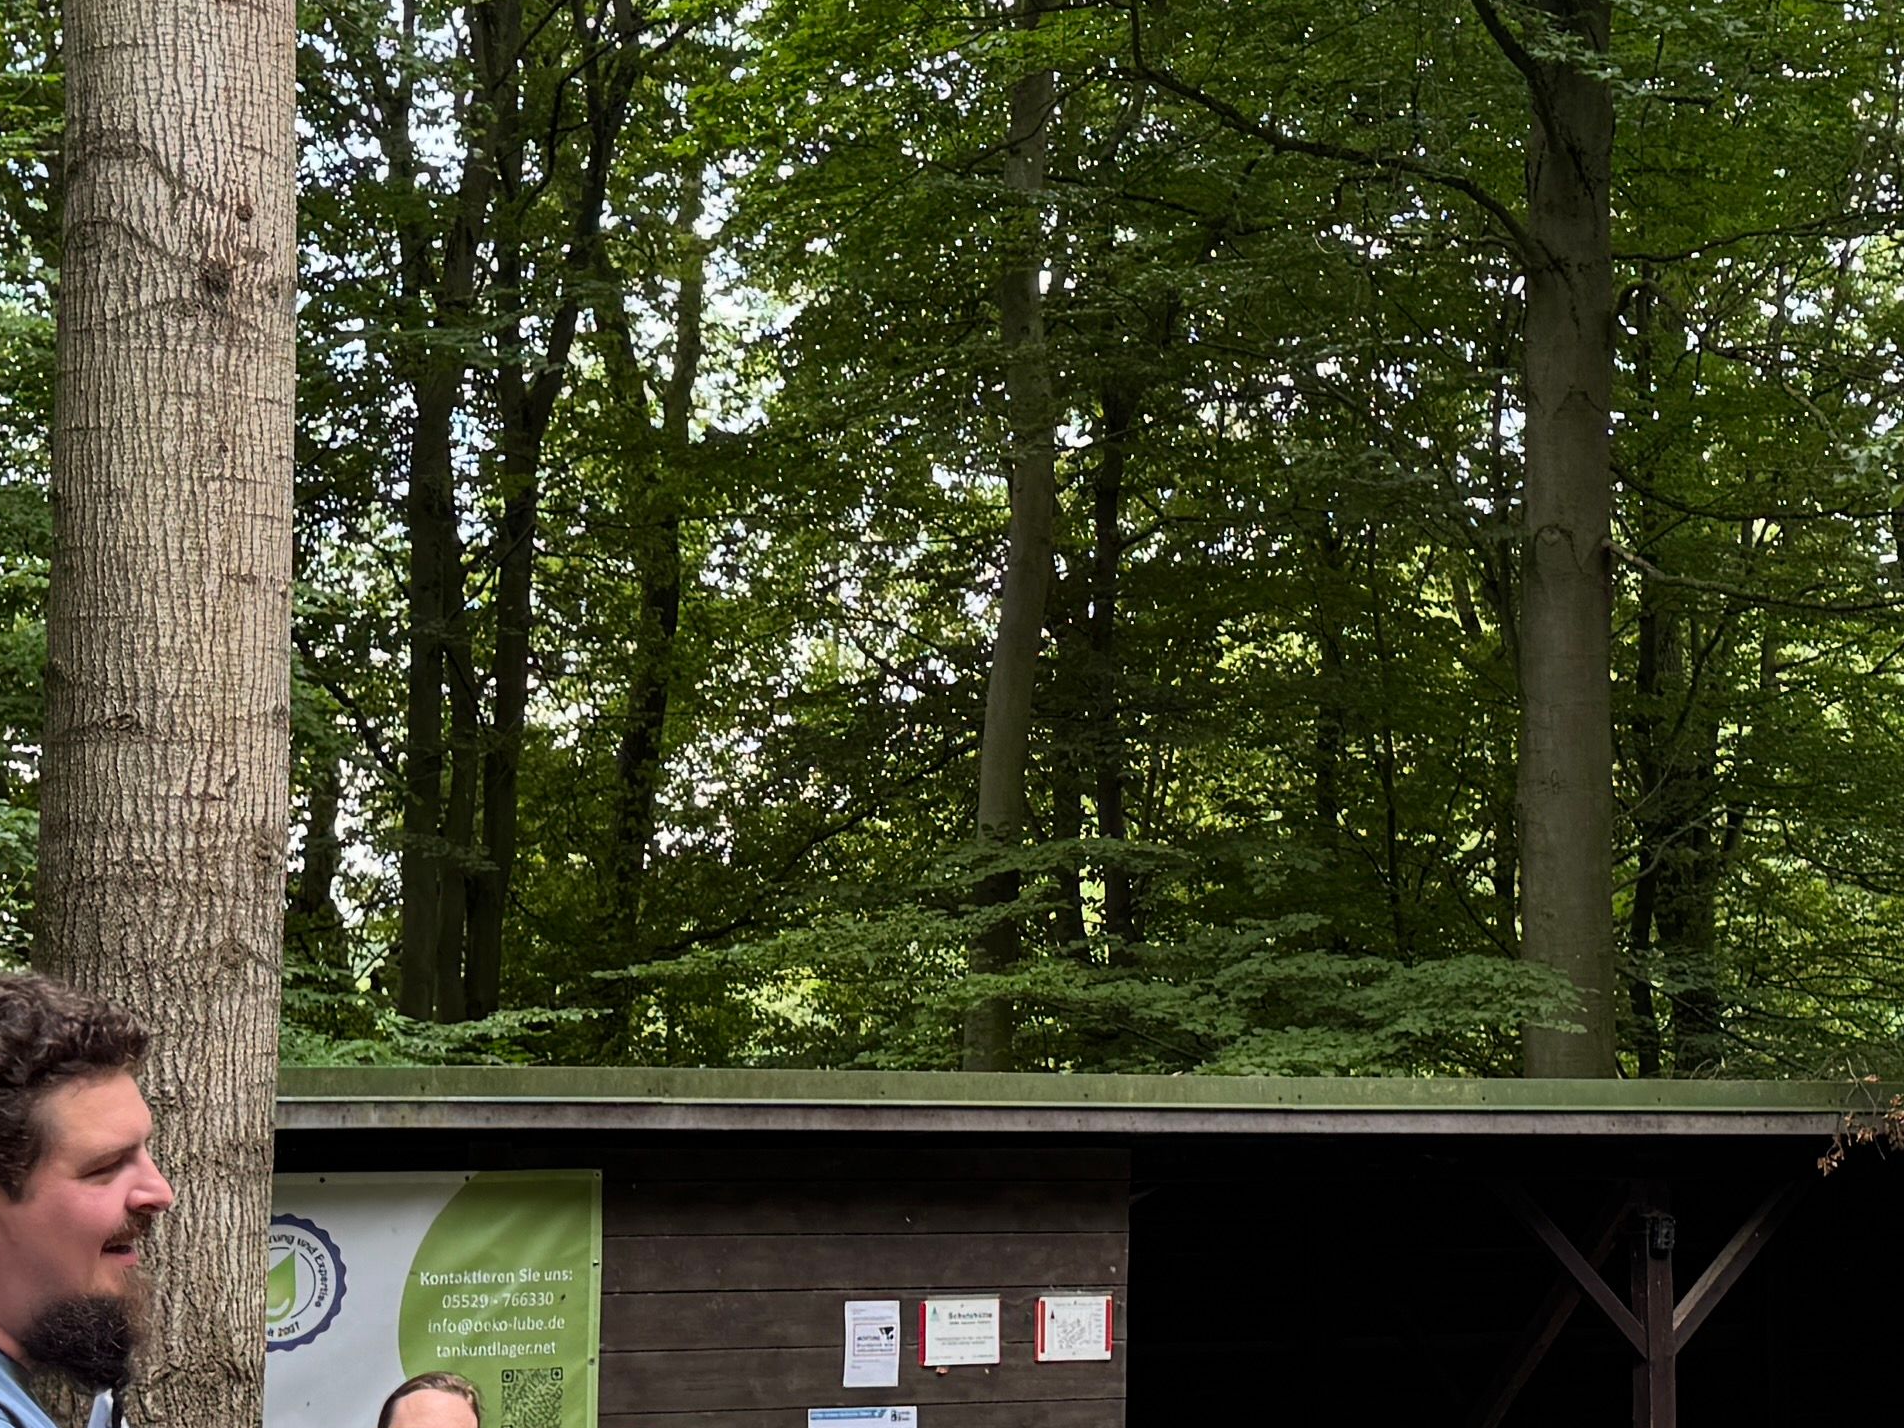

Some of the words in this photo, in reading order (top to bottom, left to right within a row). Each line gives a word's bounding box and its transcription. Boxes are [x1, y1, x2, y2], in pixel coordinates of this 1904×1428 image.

[420, 1270, 515, 1286] Kontaktieren
[519, 1268, 540, 1283] Sie
[544, 1269, 573, 1283] uns:
[442, 1294, 489, 1309] 05529
[503, 1292, 554, 1307] 766330
[428, 1316, 565, 1335] info@oeko-lube.de
[437, 1341, 556, 1358] tankundlager.net
